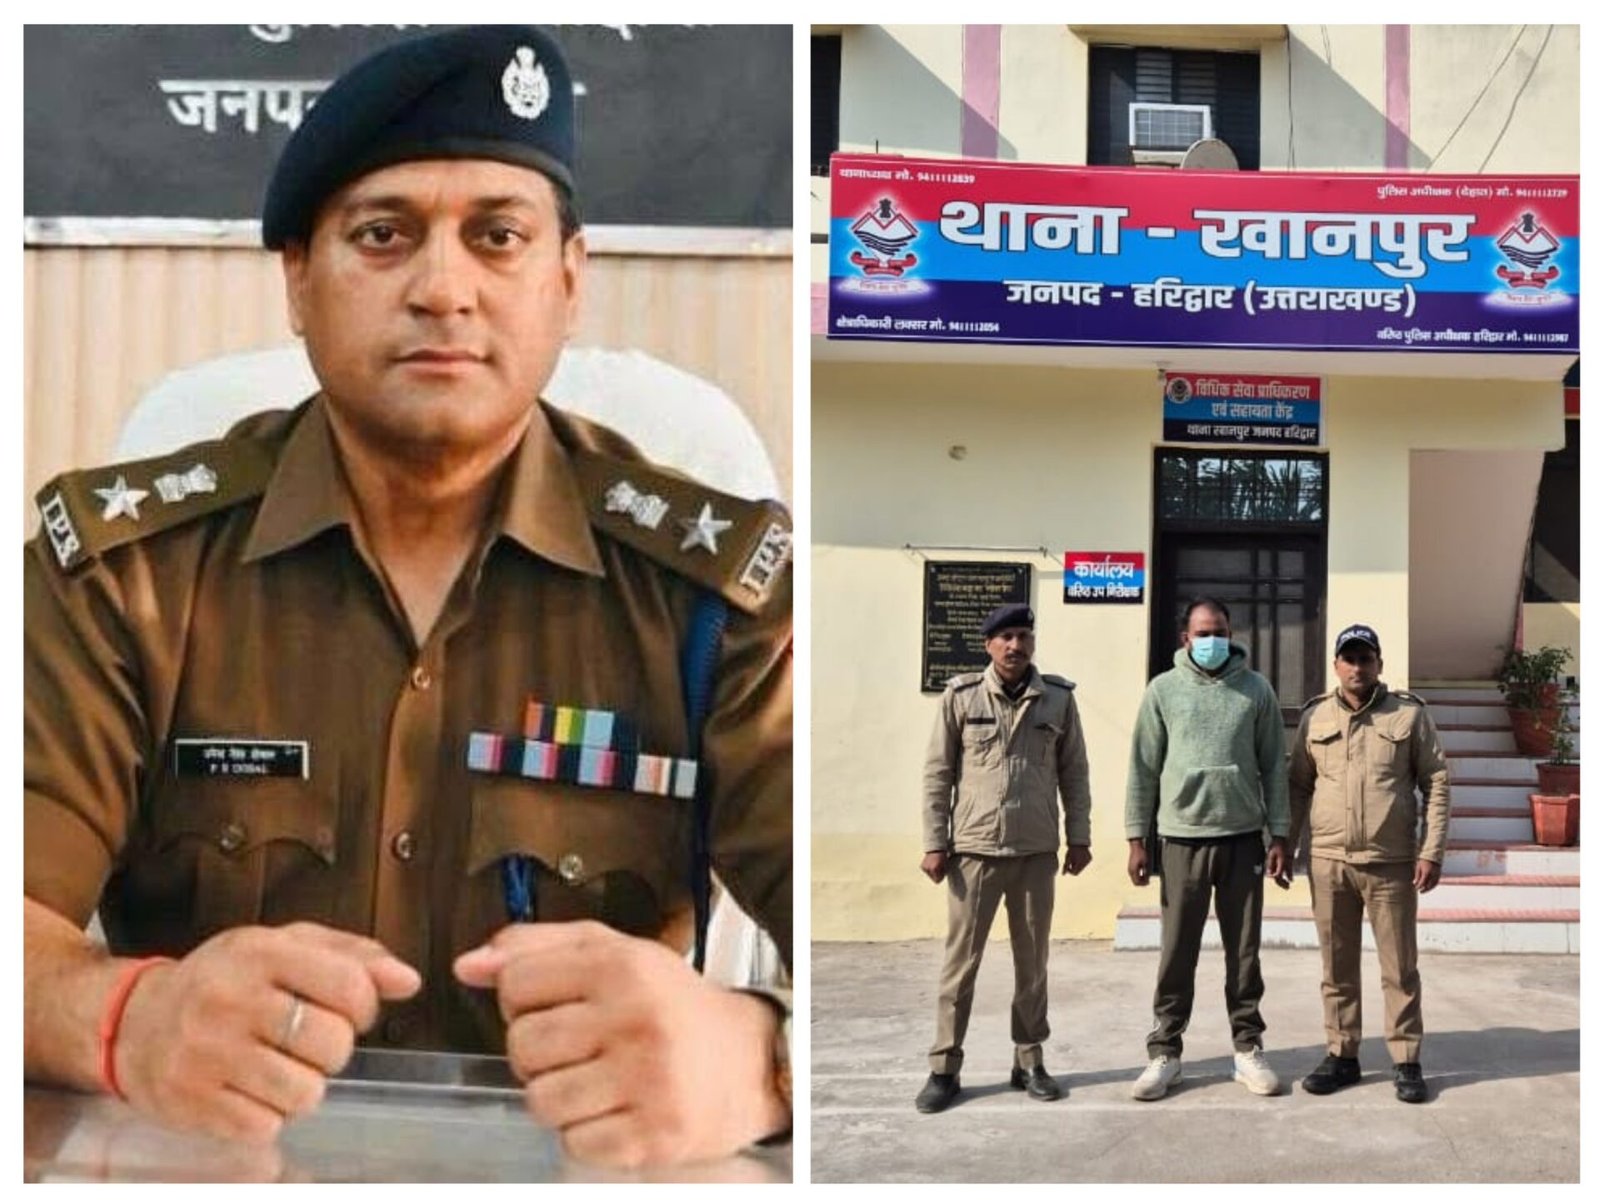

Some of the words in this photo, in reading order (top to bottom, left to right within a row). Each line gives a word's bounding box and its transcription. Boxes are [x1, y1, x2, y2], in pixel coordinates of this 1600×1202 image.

[1377, 183, 1407, 199] पुलिस
[1410, 184, 1452, 197] अधीक्षक
[939, 200, 1128, 256] थाना
[1194, 209, 1476, 278] खानपुर
[1003, 279, 1104, 306] जनपद
[1131, 276, 1236, 312] हरिद्वार
[1243, 279, 1416, 317] (उत्तराखण्ड)
[836, 314, 892, 330] क्षेत्राधिकारी
[894, 319, 928, 331] लक्सर
[929, 317, 946, 331] मो.
[1404, 328, 1431, 344] पुलिस
[1433, 328, 1471, 342] अधीक्षक
[1473, 329, 1504, 343] हरिद्वार
[1195, 378, 1231, 397] विधिक
[1233, 379, 1255, 397] सेवा
[1258, 380, 1311, 399] प्राधिकरण
[1211, 400, 1227, 417] एवं
[1230, 402, 1273, 418] सहायता
[1187, 424, 1211, 436] थाना
[1213, 424, 1250, 440] खानपुर
[1252, 426, 1283, 438] जनपद
[1284, 424, 1317, 440] हरिद्वार
[1072, 554, 1136, 579] कार्यालय
[1092, 586, 1105, 598] उप
